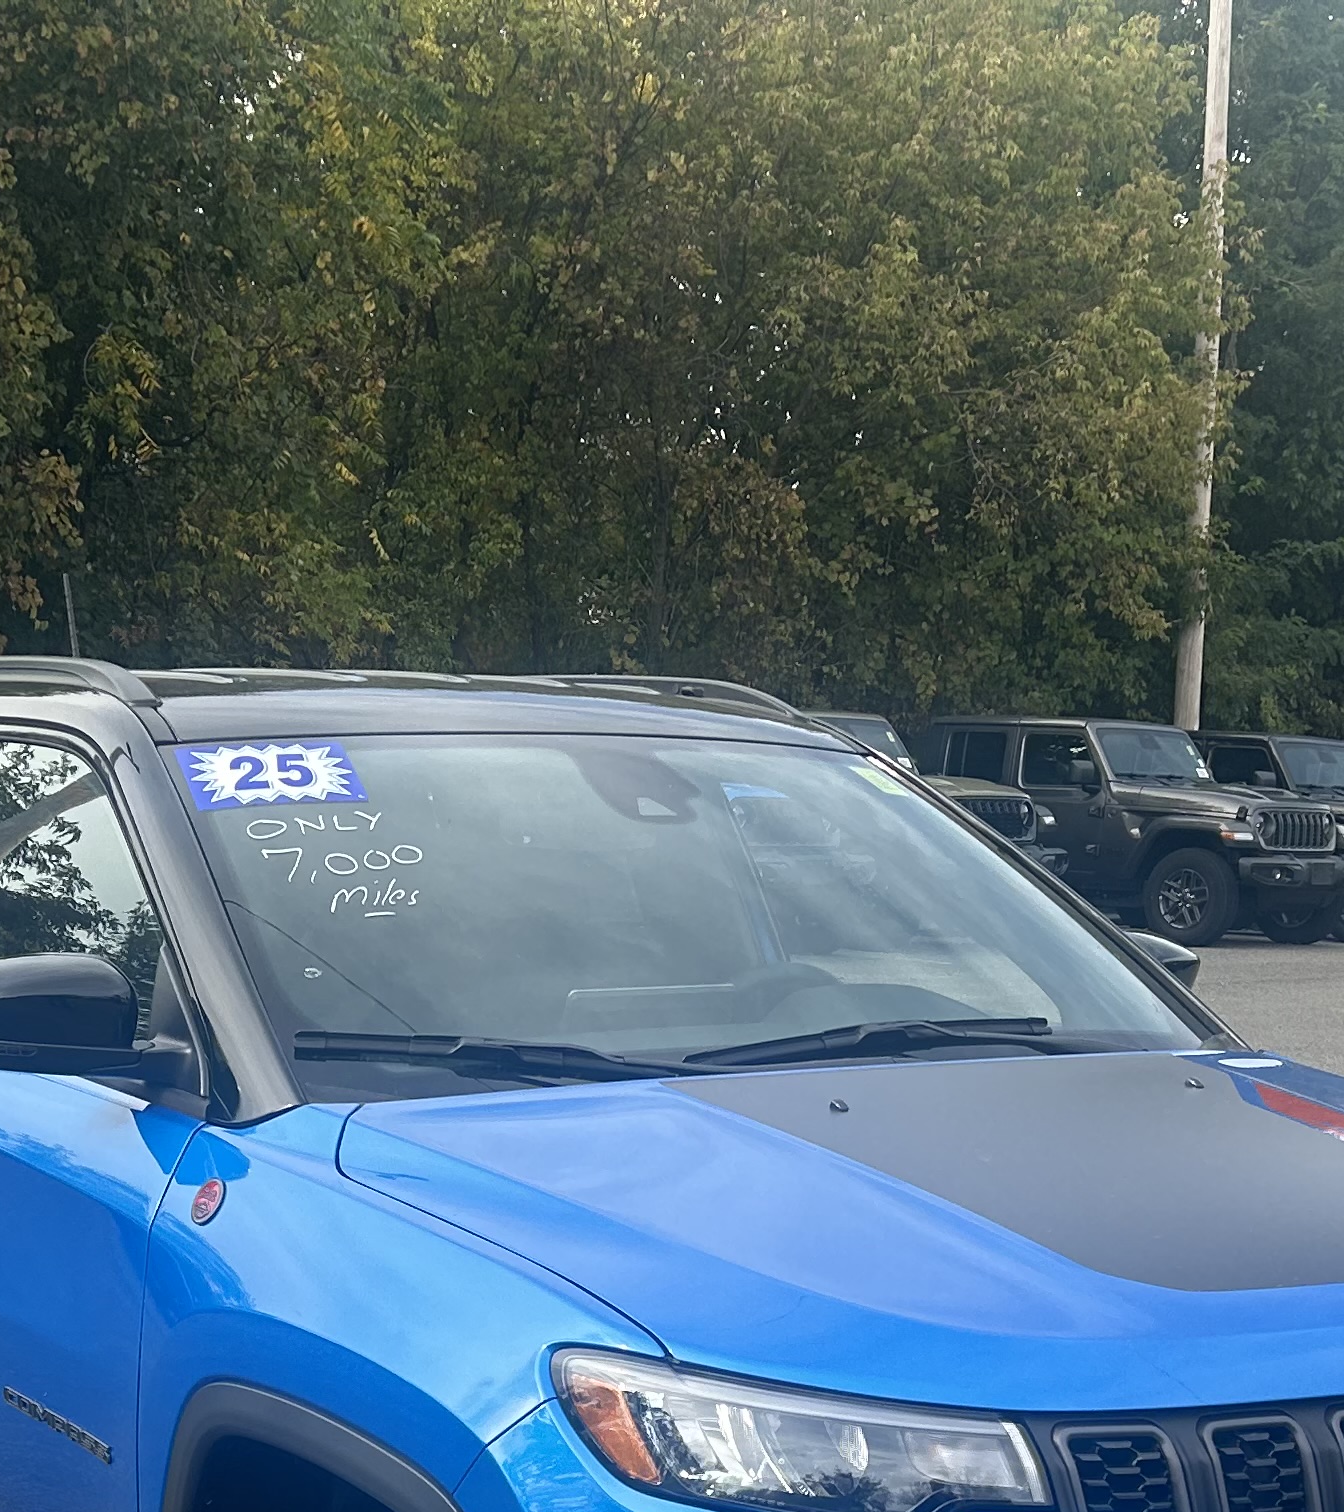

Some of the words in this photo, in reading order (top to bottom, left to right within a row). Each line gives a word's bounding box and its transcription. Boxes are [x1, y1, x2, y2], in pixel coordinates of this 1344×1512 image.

[229, 753, 316, 791] 25
[246, 810, 382, 839] ONLY
[261, 844, 424, 884] 7,000
[3, 1385, 113, 1465] COMPASS
